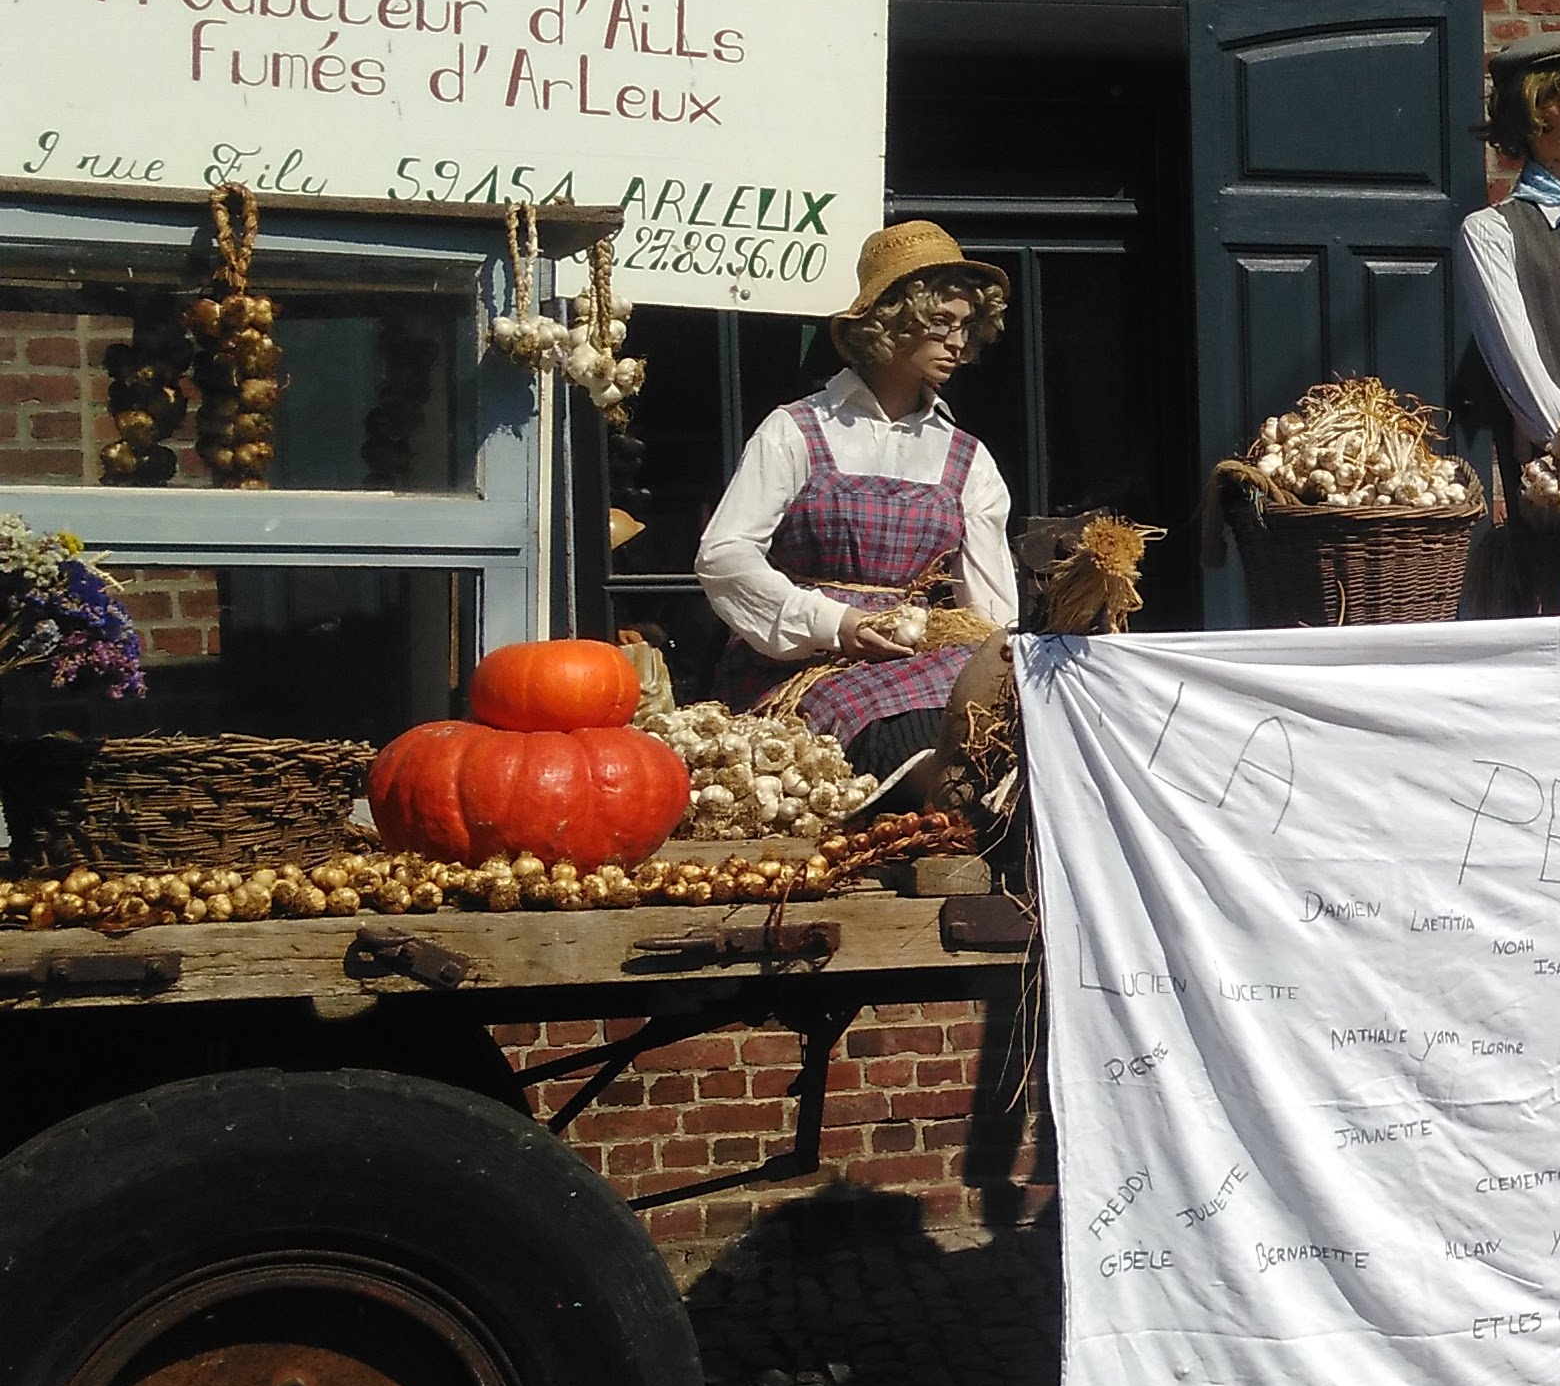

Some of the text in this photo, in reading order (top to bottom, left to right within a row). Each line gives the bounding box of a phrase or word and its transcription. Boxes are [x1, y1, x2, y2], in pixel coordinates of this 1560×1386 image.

[23, 129, 60, 174] 9
[76, 154, 165, 182] rue
[617, 176, 838, 236] ARLEUX
[572, 225, 828, 284] .27.89.56.00
[1147, 681, 1295, 835] LA
[1299, 890, 1381, 922] DAMIEN
[1076, 923, 1299, 1002] LUCIEN LUCETTE
[1492, 939, 1535, 955] NOAH
[1331, 1026, 1407, 1051] NATHALIE
[1334, 1119, 1433, 1151] JANNETTE
[1088, 1165, 1154, 1240] FREDDY
[1176, 1164, 1249, 1229] JULIETTE
[1100, 1242, 1175, 1278] GISELE
[1255, 1242, 1371, 1274] BERNADETTE
[1445, 1239, 1502, 1261] ALLAN
[1472, 1317, 1502, 1341] ET
[1508, 1312, 1543, 1336] LES
